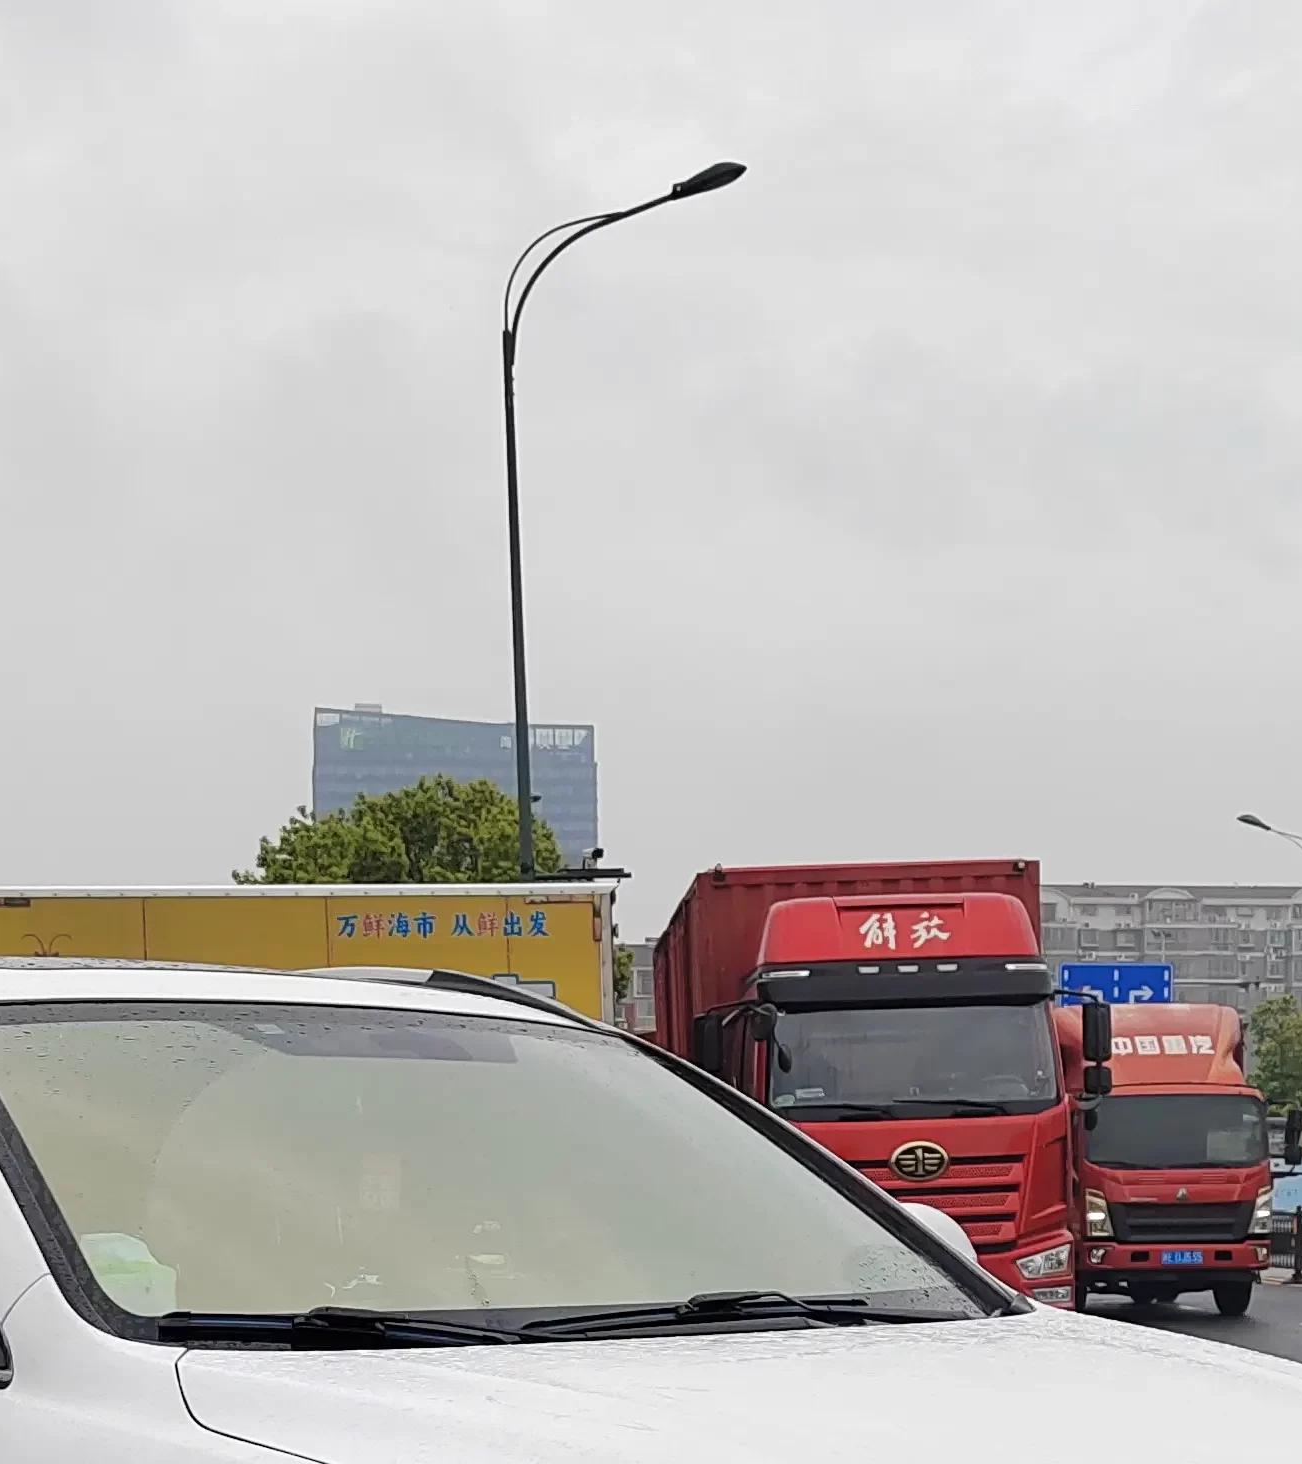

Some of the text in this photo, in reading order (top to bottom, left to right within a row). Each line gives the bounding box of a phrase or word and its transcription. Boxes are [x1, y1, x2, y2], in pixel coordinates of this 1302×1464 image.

[336, 910, 550, 939] 万鲜海市 从鲜出发
[859, 911, 952, 951] 解放
